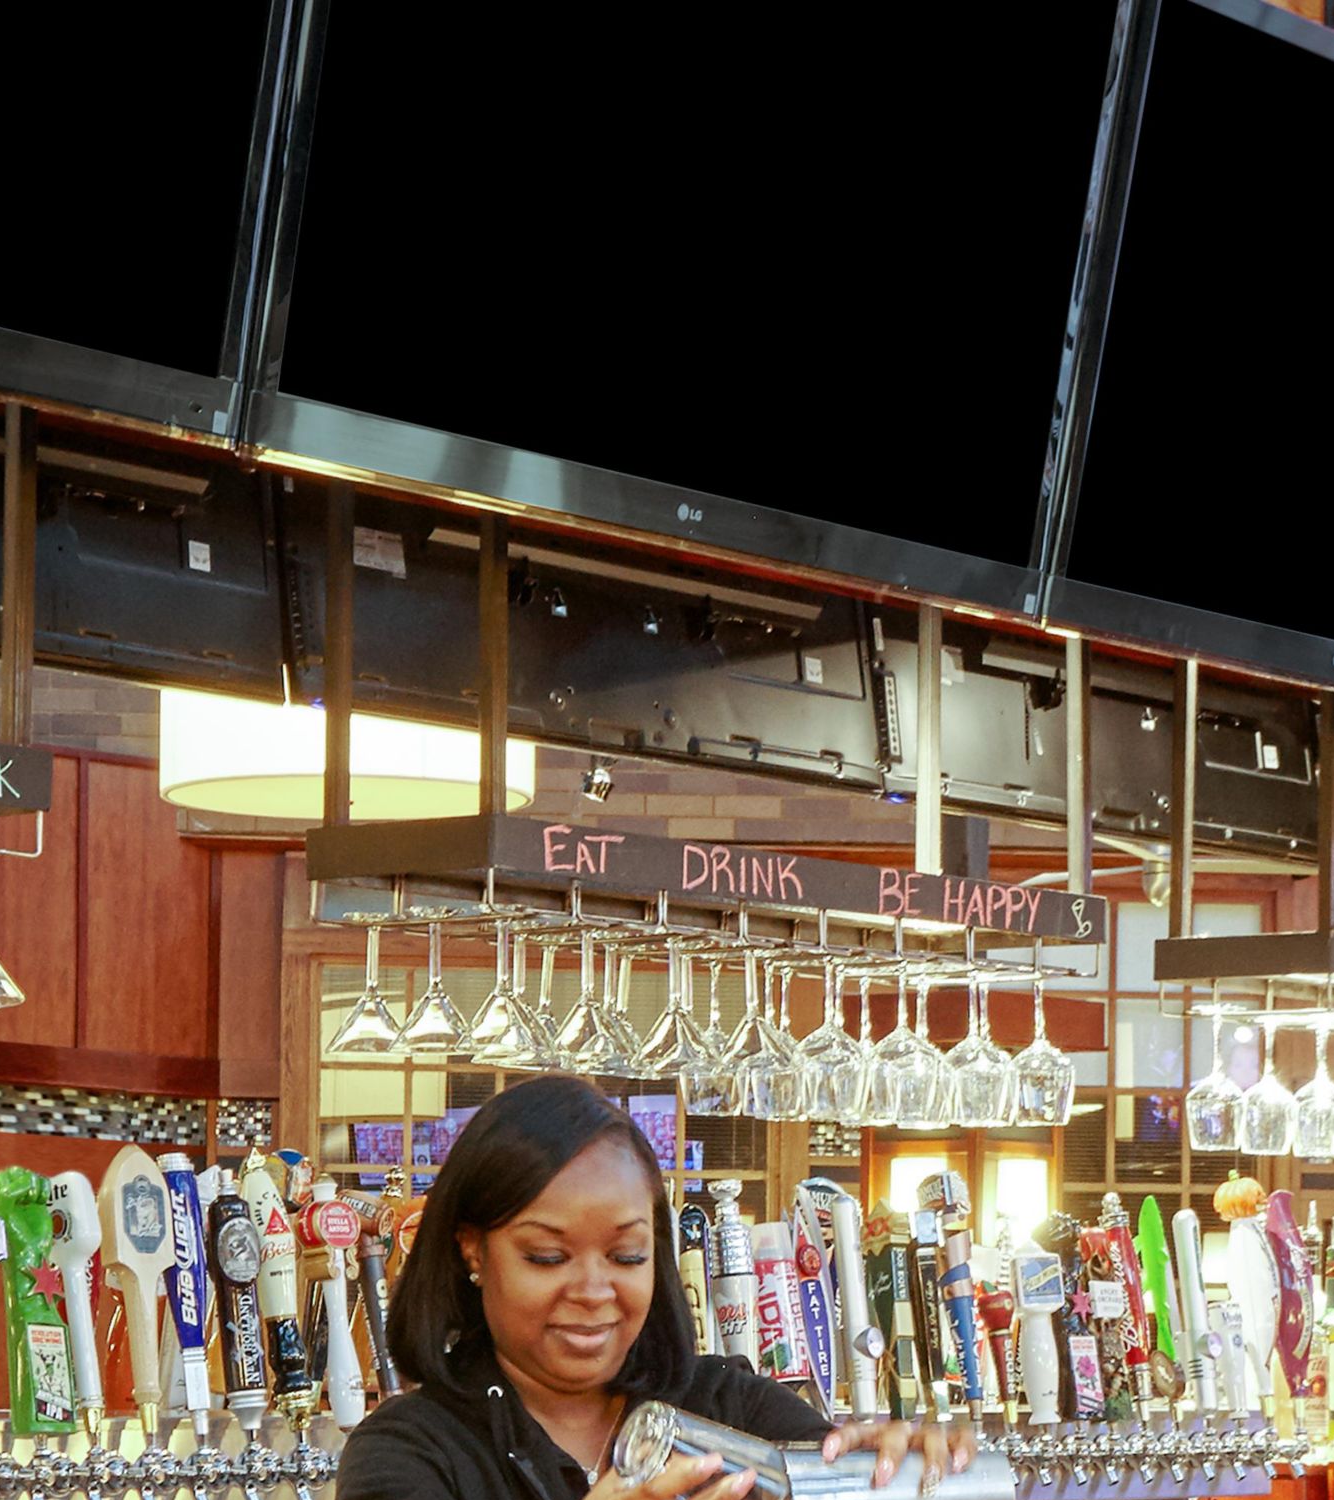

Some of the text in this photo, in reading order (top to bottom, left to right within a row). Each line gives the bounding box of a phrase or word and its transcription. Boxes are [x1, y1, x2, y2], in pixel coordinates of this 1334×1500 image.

[542, 823, 1042, 932] EAT DRINK BE HAPPY
[170, 1187, 198, 1327] BUD LIGHT
[806, 1282, 831, 1377] FAT TIRE
